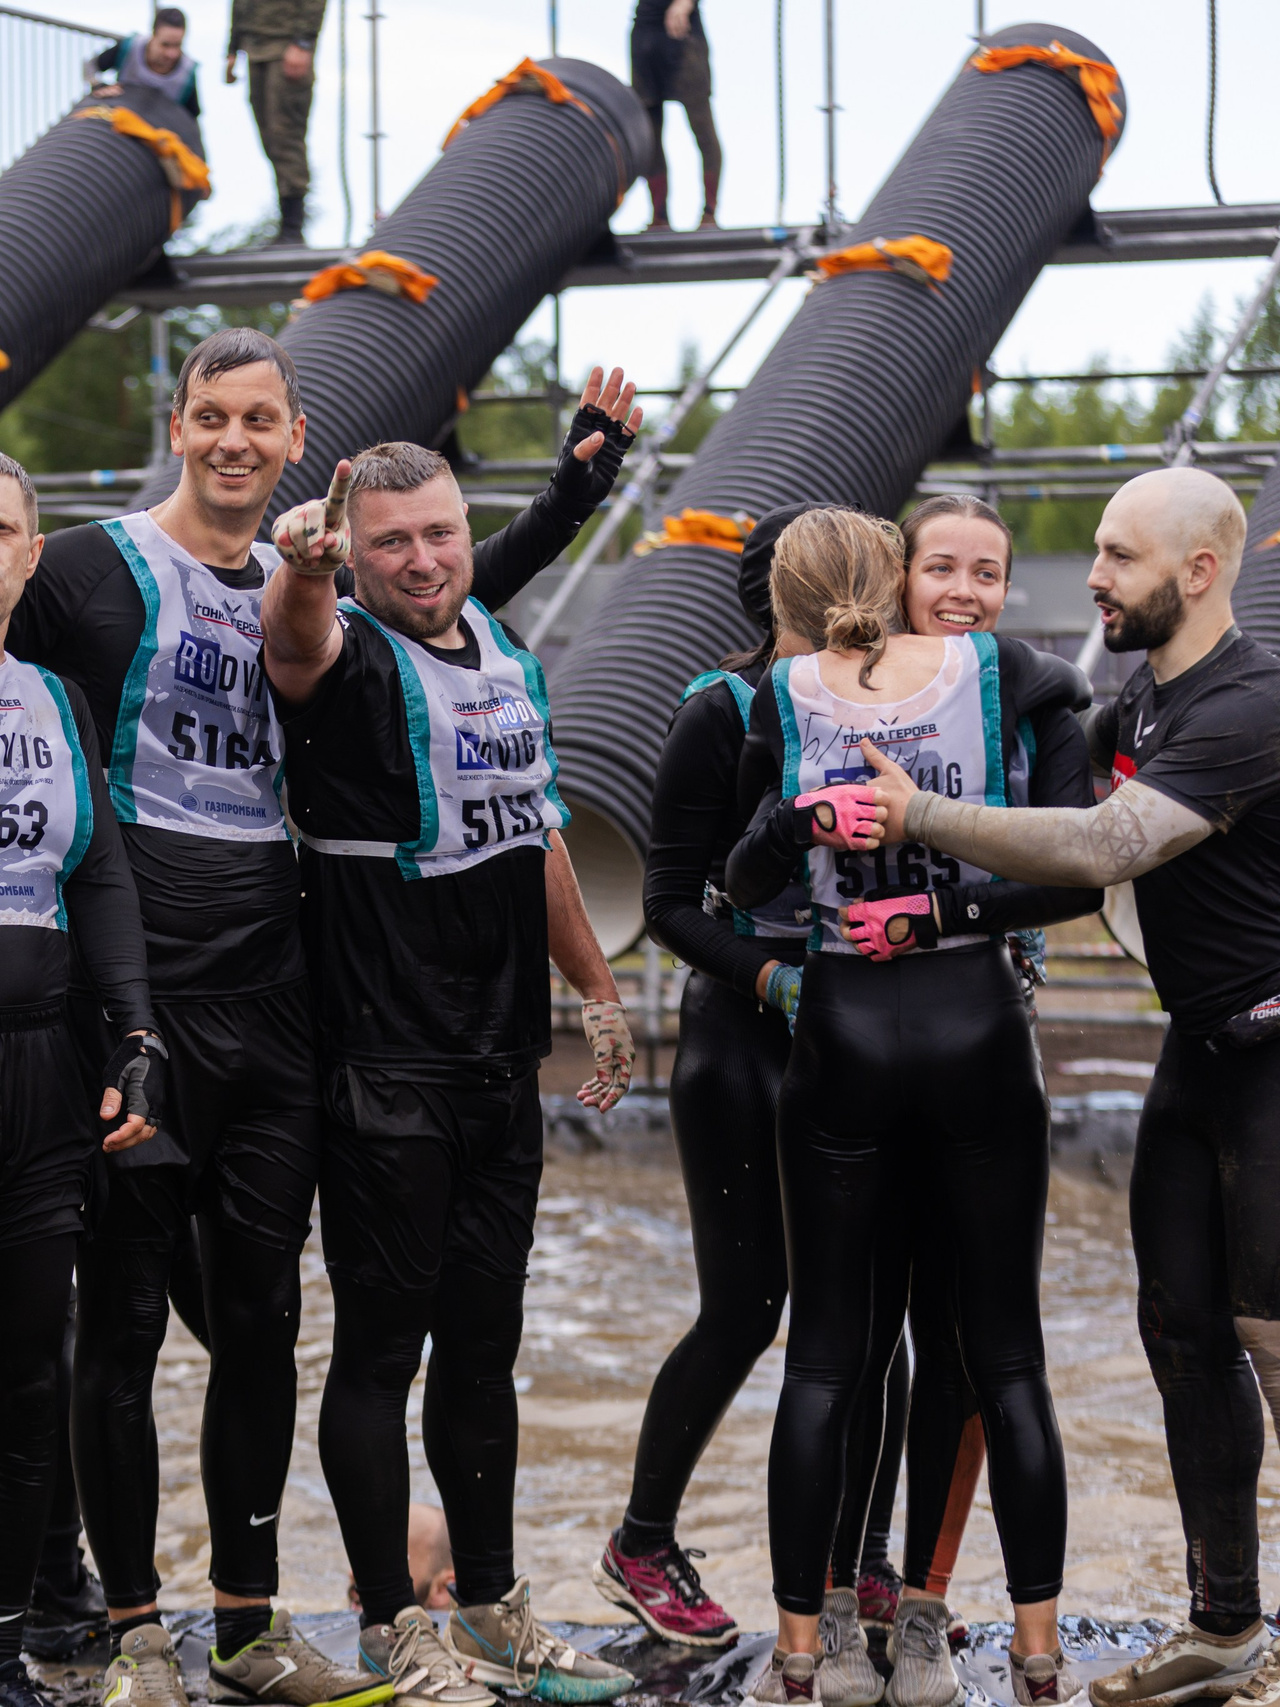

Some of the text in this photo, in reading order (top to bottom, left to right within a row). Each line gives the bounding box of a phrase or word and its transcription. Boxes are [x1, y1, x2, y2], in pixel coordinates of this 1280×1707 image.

[230, 617, 263, 635] ГЕРОЕ
[888, 723, 937, 740] ГЕРОЕВ
[205, 801, 267, 818] ГАЗПРОМБАНК
[835, 843, 960, 898] 5165
